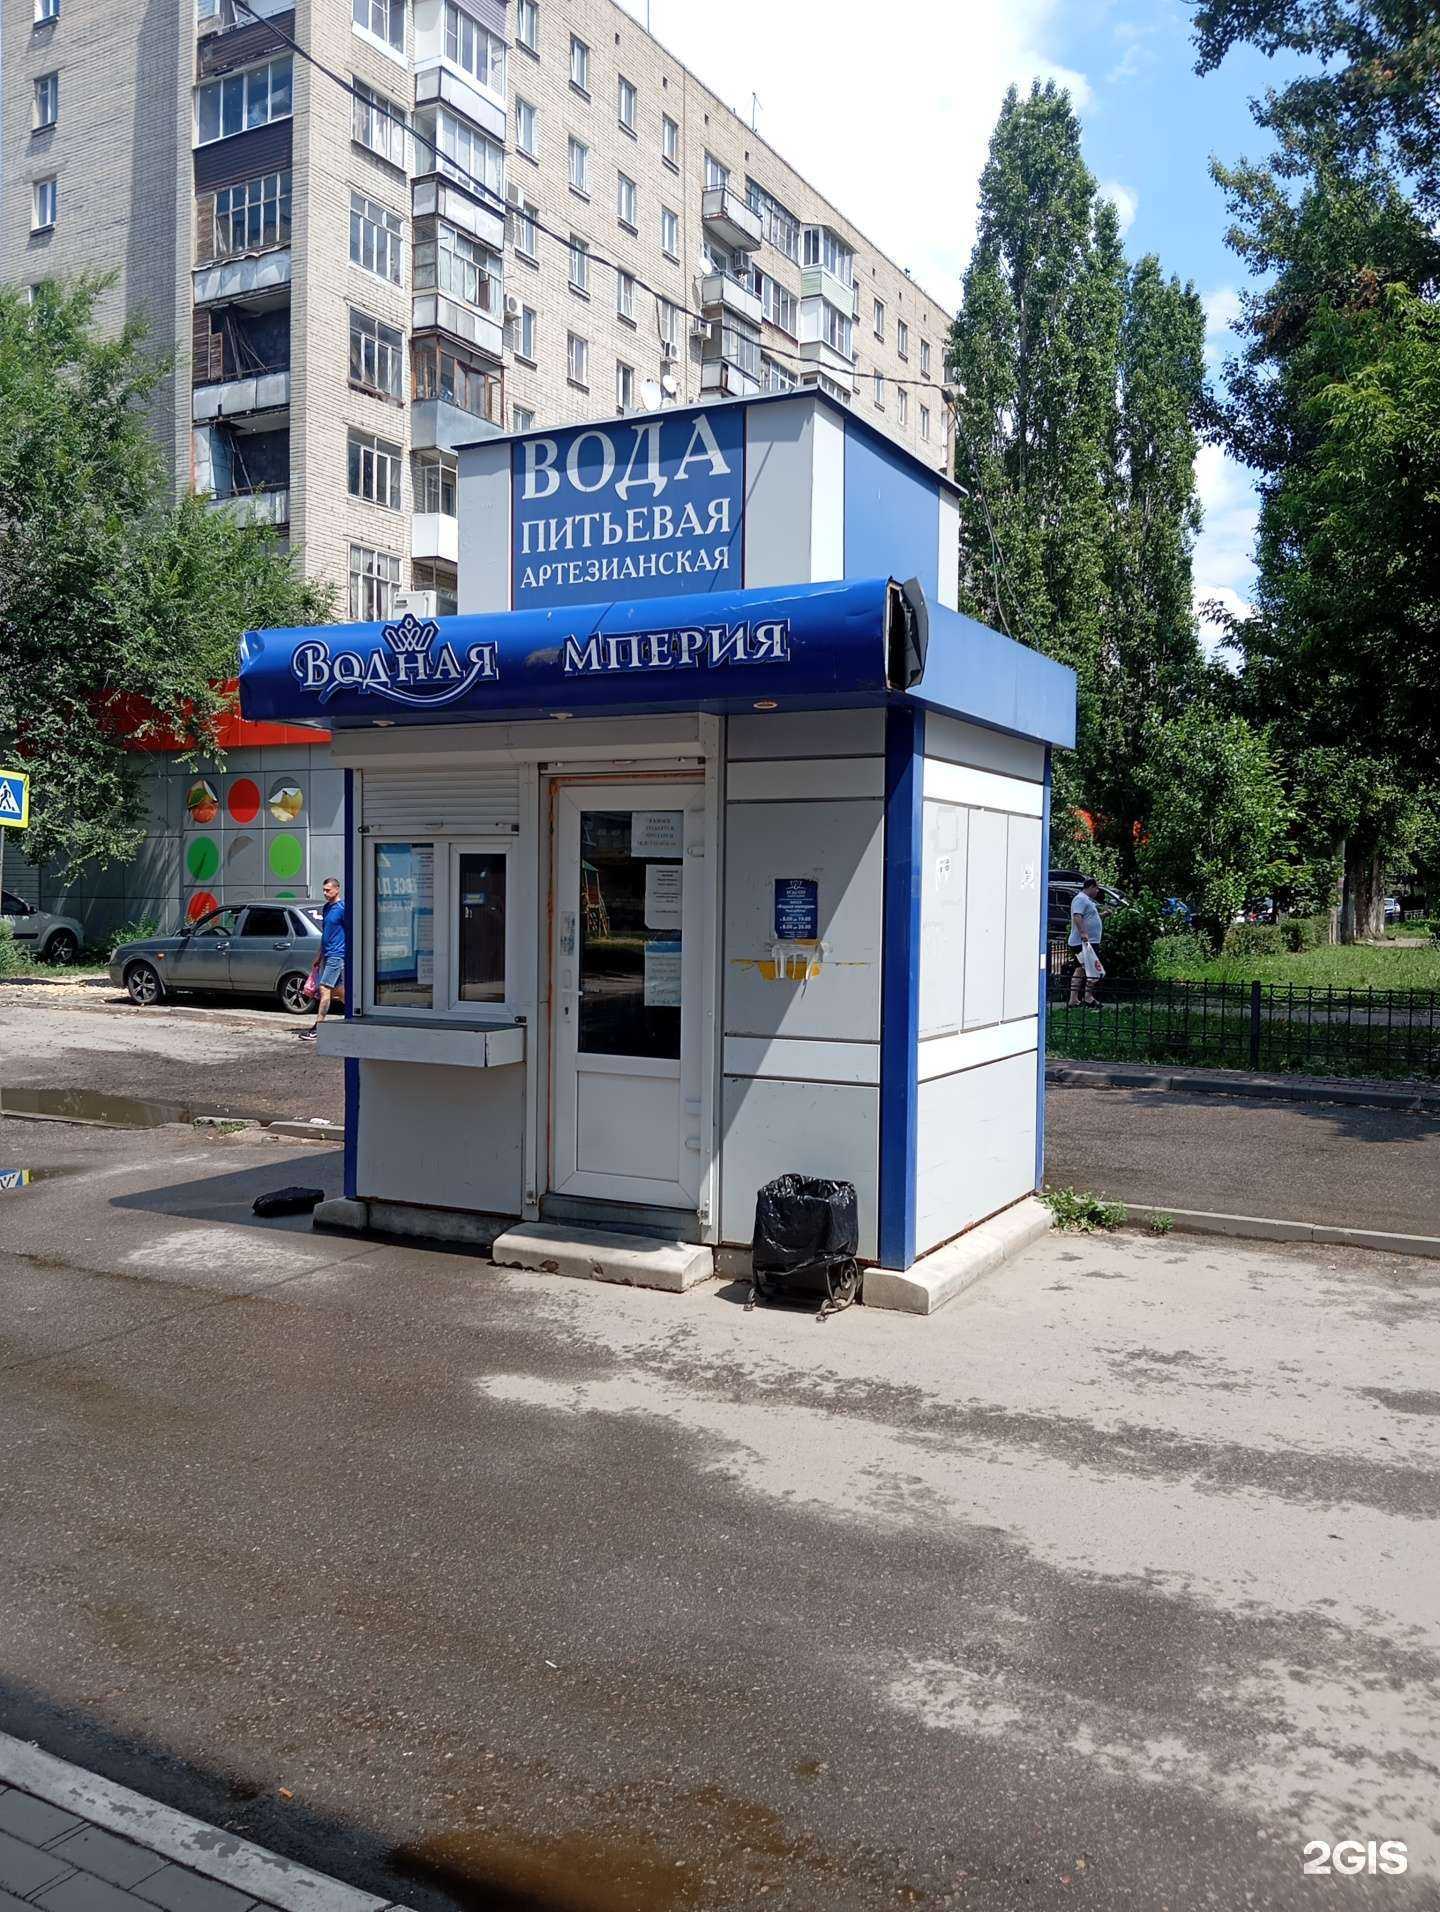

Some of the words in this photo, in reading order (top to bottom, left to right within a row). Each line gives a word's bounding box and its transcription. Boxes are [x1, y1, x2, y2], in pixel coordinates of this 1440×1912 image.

[521, 413, 732, 501] ВОДА
[520, 497, 732, 555] ПИТЬЕВАЯ
[520, 545, 730, 590] АРТЕЗИАНСКАЯ
